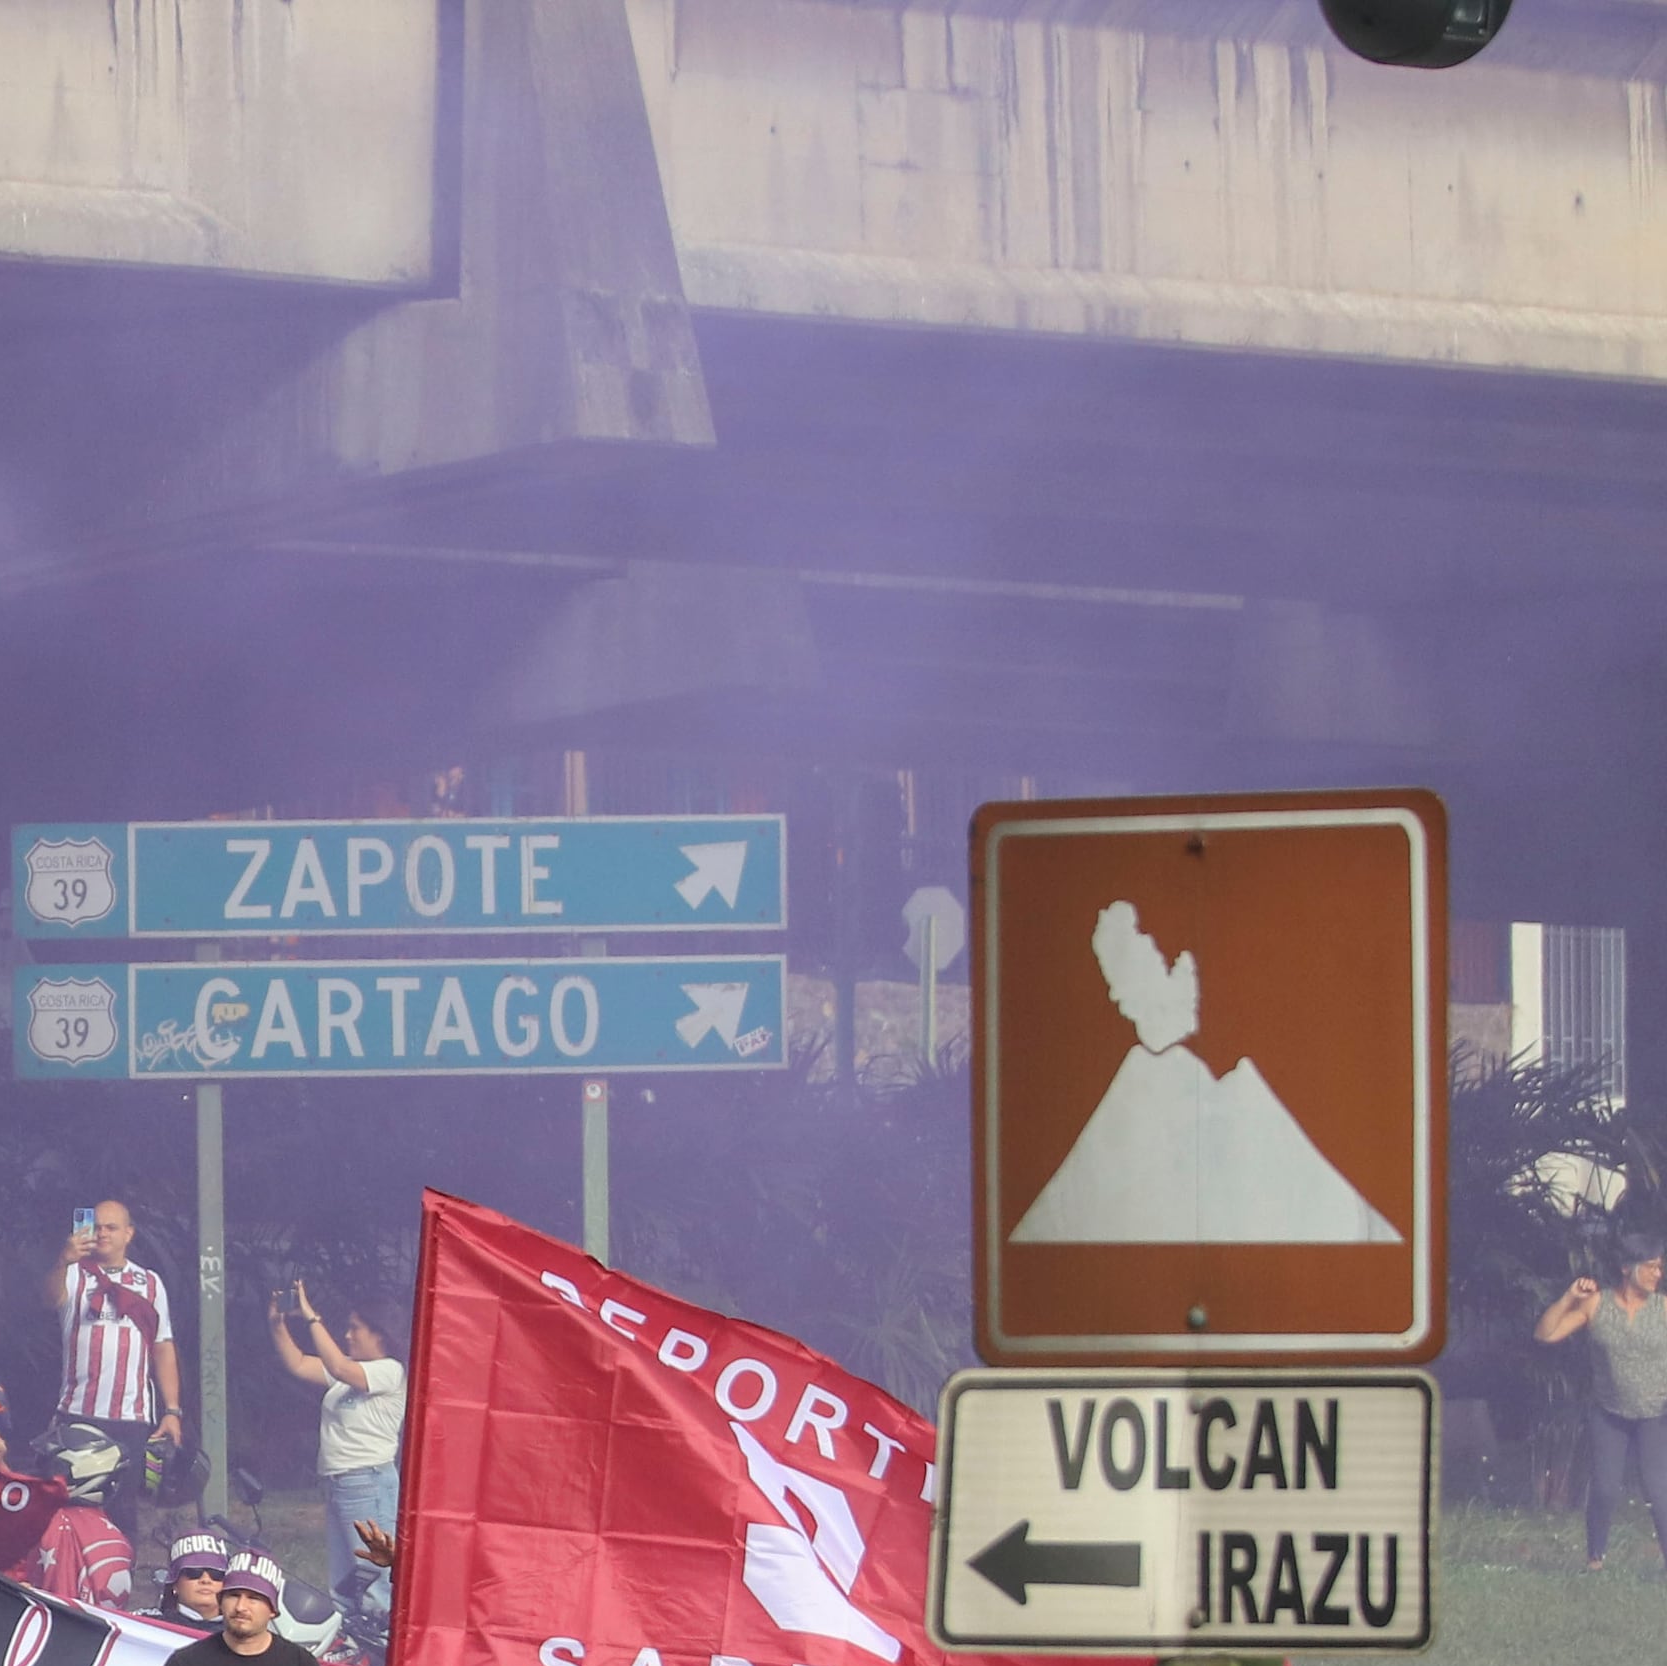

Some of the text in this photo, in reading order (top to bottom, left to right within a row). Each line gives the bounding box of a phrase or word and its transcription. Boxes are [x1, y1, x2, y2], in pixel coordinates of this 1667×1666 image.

[35, 855, 103, 870] COSTA RICA
[53, 878, 88, 911] 39
[223, 833, 564, 920] ZAPOTE
[55, 1017, 89, 1049] 39
[196, 974, 601, 1060] CARTAGO
[1045, 1398, 1339, 1491] VOLCAN
[1198, 1531, 1399, 1628] IRAZU
